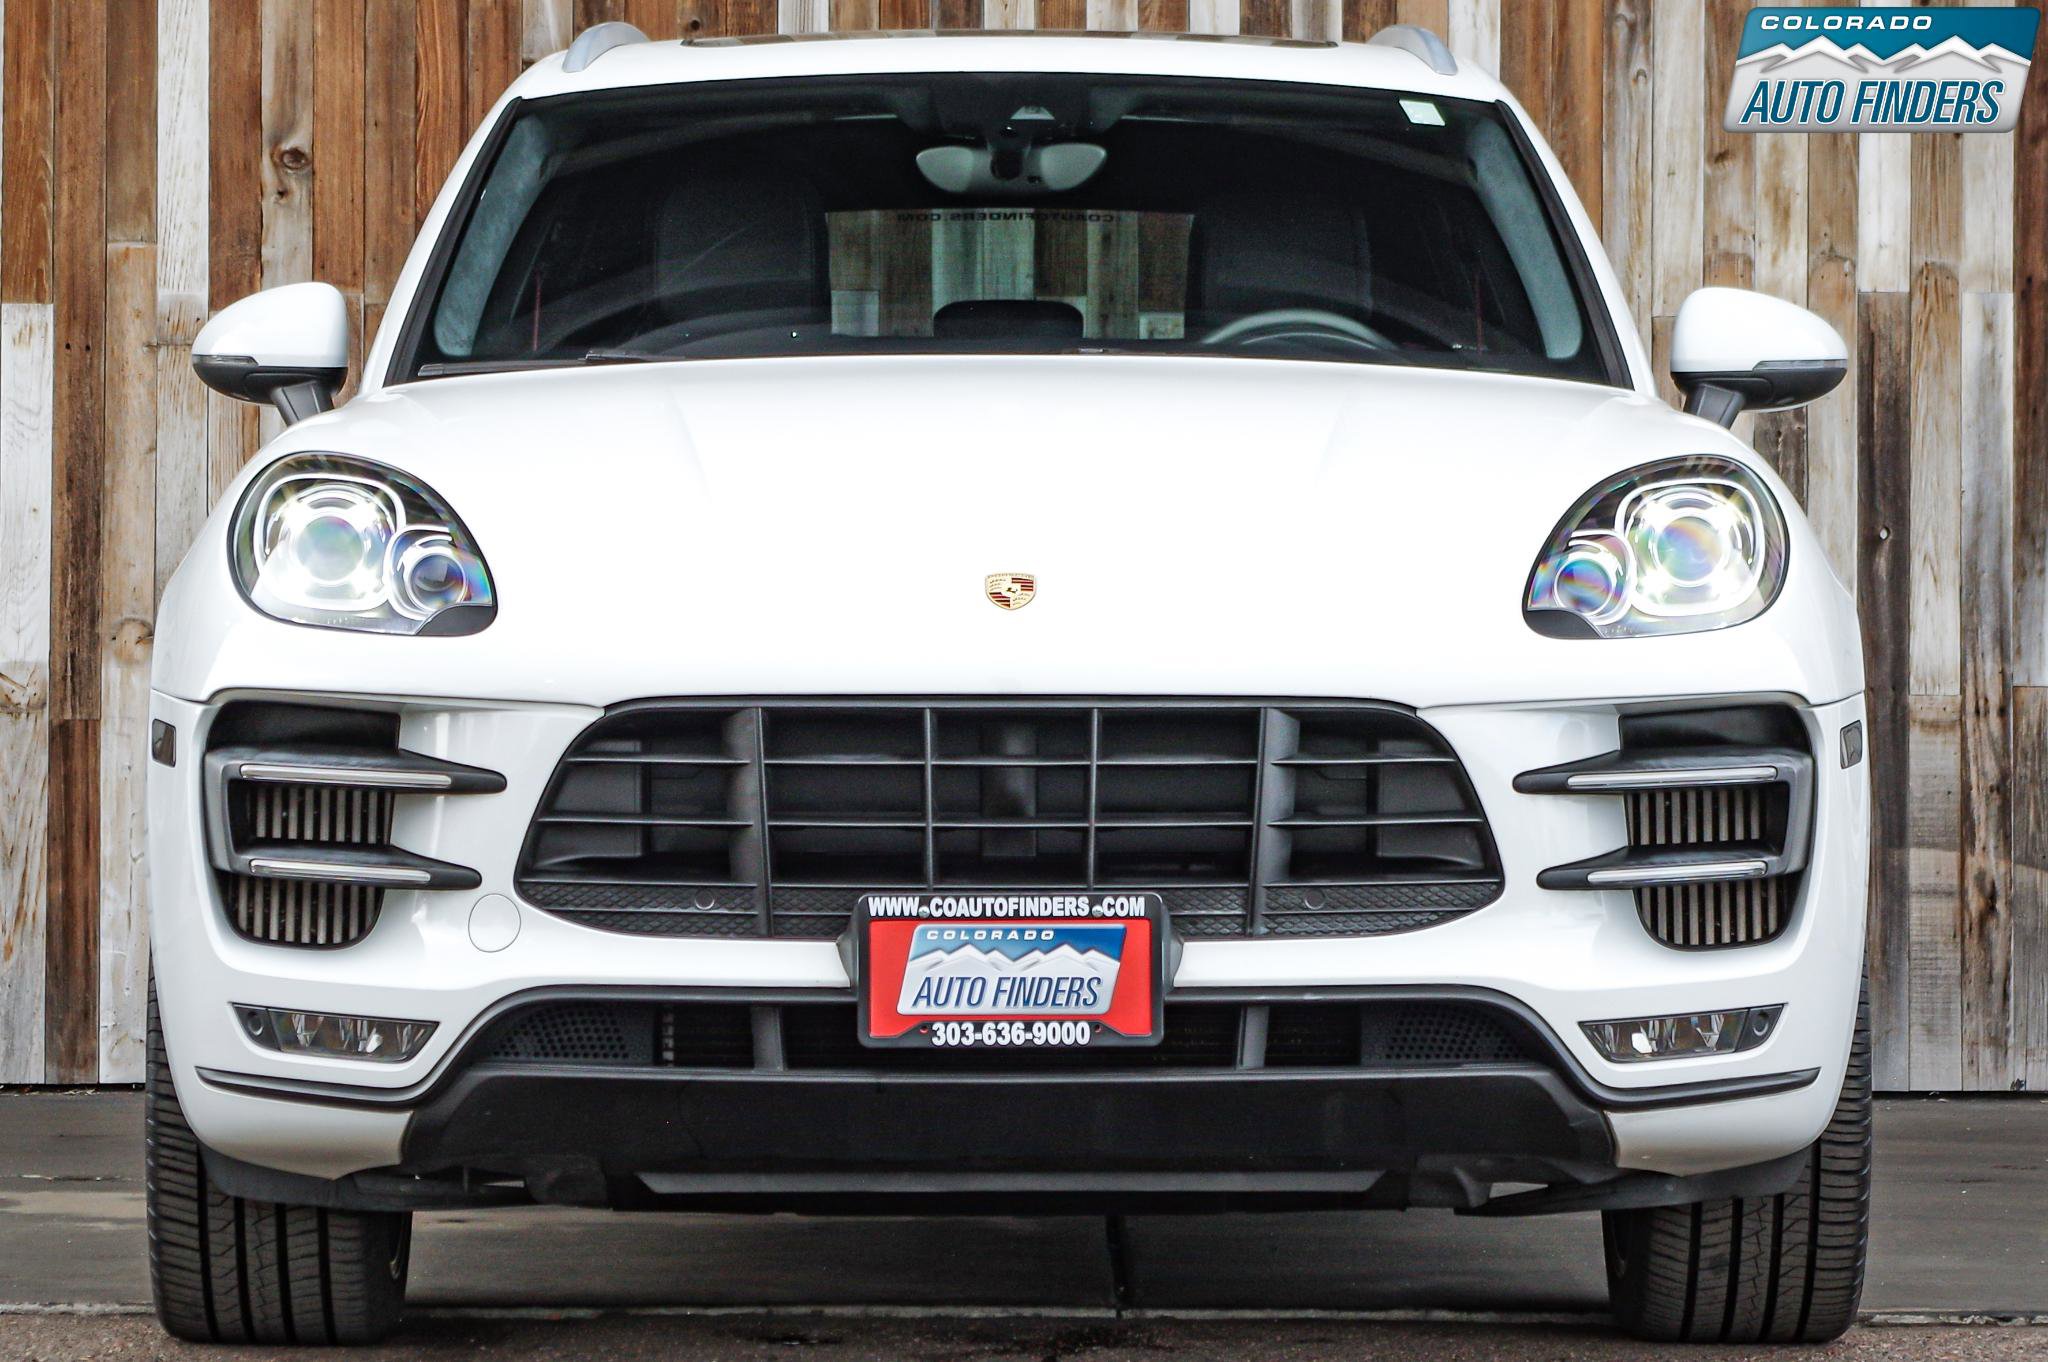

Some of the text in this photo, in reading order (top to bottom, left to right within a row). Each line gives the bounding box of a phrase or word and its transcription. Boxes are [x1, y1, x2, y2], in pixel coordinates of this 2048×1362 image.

[926, 930, 1055, 941] COLORADO
[912, 976, 1102, 1009] AUTO FINDERS
[931, 1021, 1091, 1046] 303-636-9000
